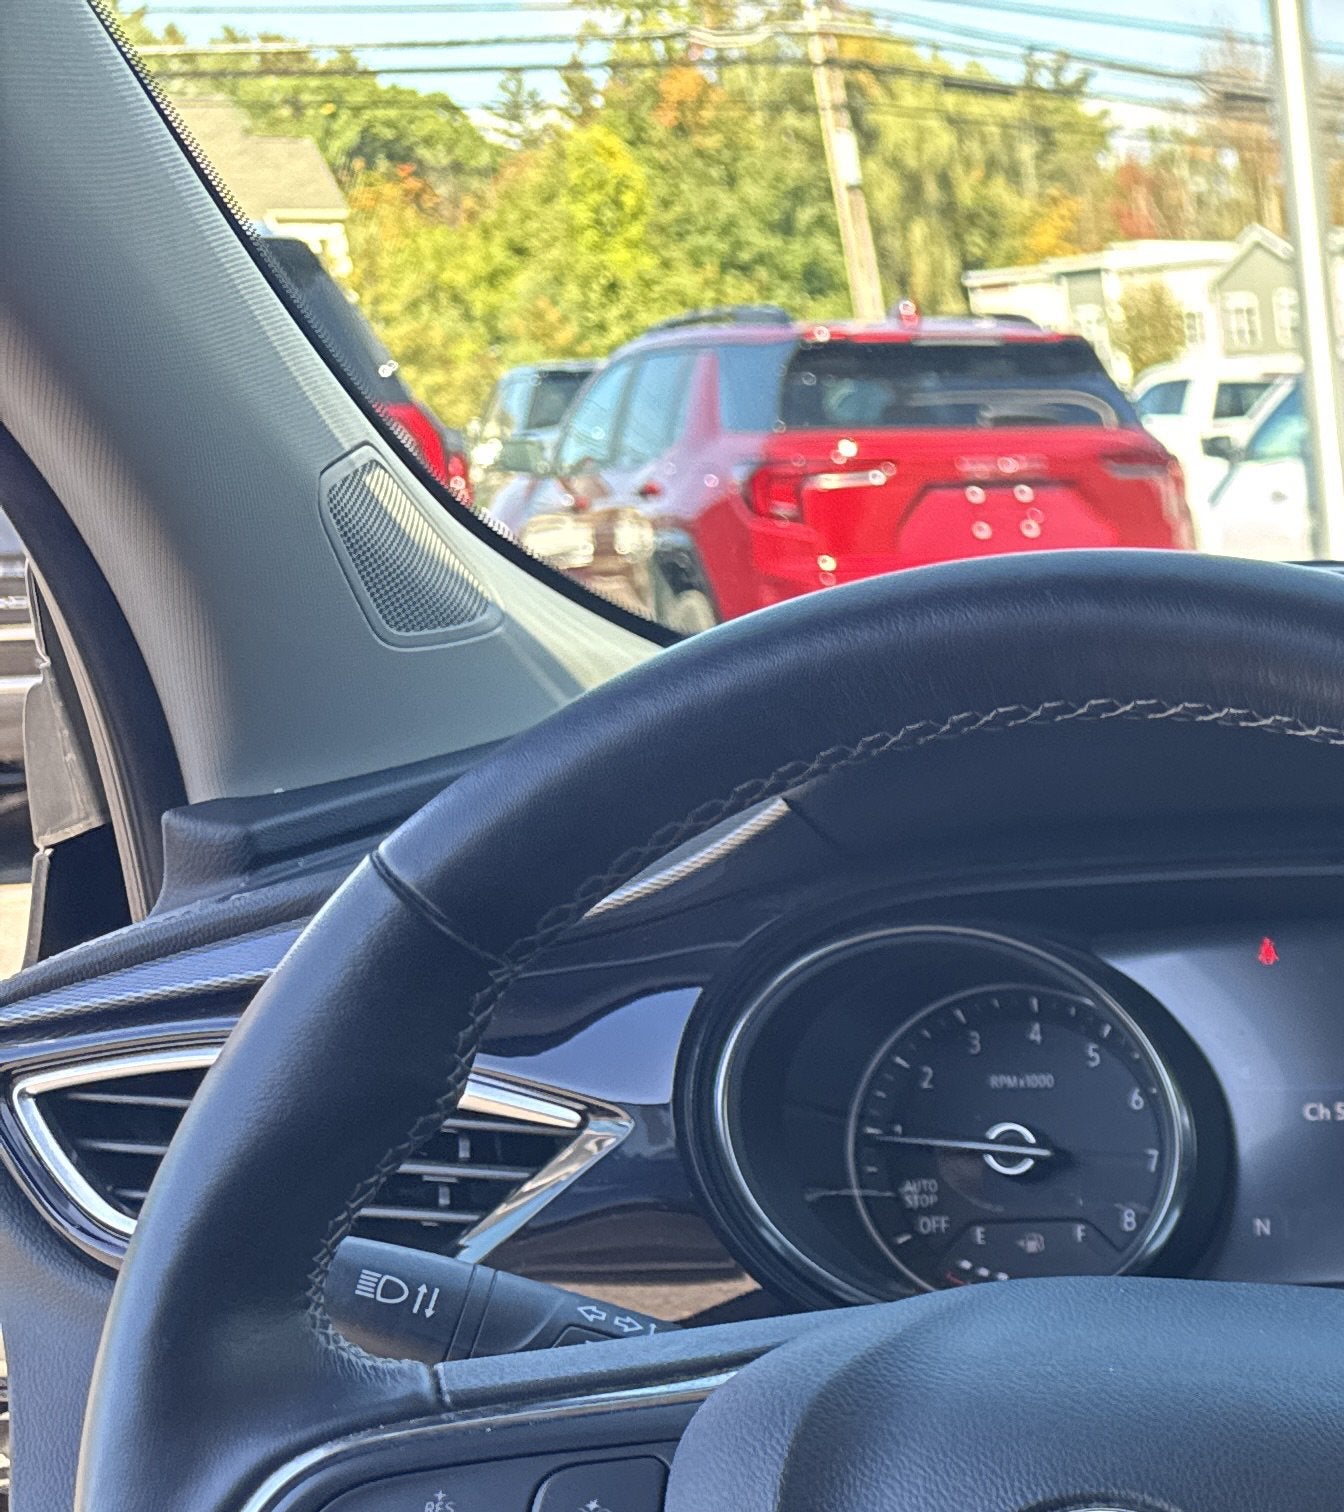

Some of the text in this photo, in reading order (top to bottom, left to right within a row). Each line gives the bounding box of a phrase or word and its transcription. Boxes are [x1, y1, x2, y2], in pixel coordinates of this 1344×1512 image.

[969, 1031, 981, 1054] 3
[1029, 1022, 1042, 1045] 4
[1086, 1042, 1100, 1068] 5
[921, 1065, 934, 1089] 2
[1130, 1087, 1144, 1110] 6
[1303, 1102, 1331, 1121] Ch
[1147, 1149, 1160, 1172] 7
[919, 1217, 950, 1234] OFF
[1122, 1209, 1137, 1231] 8
[1253, 1218, 1272, 1237] N
[975, 1226, 986, 1245] E
[1075, 1224, 1086, 1243] F
